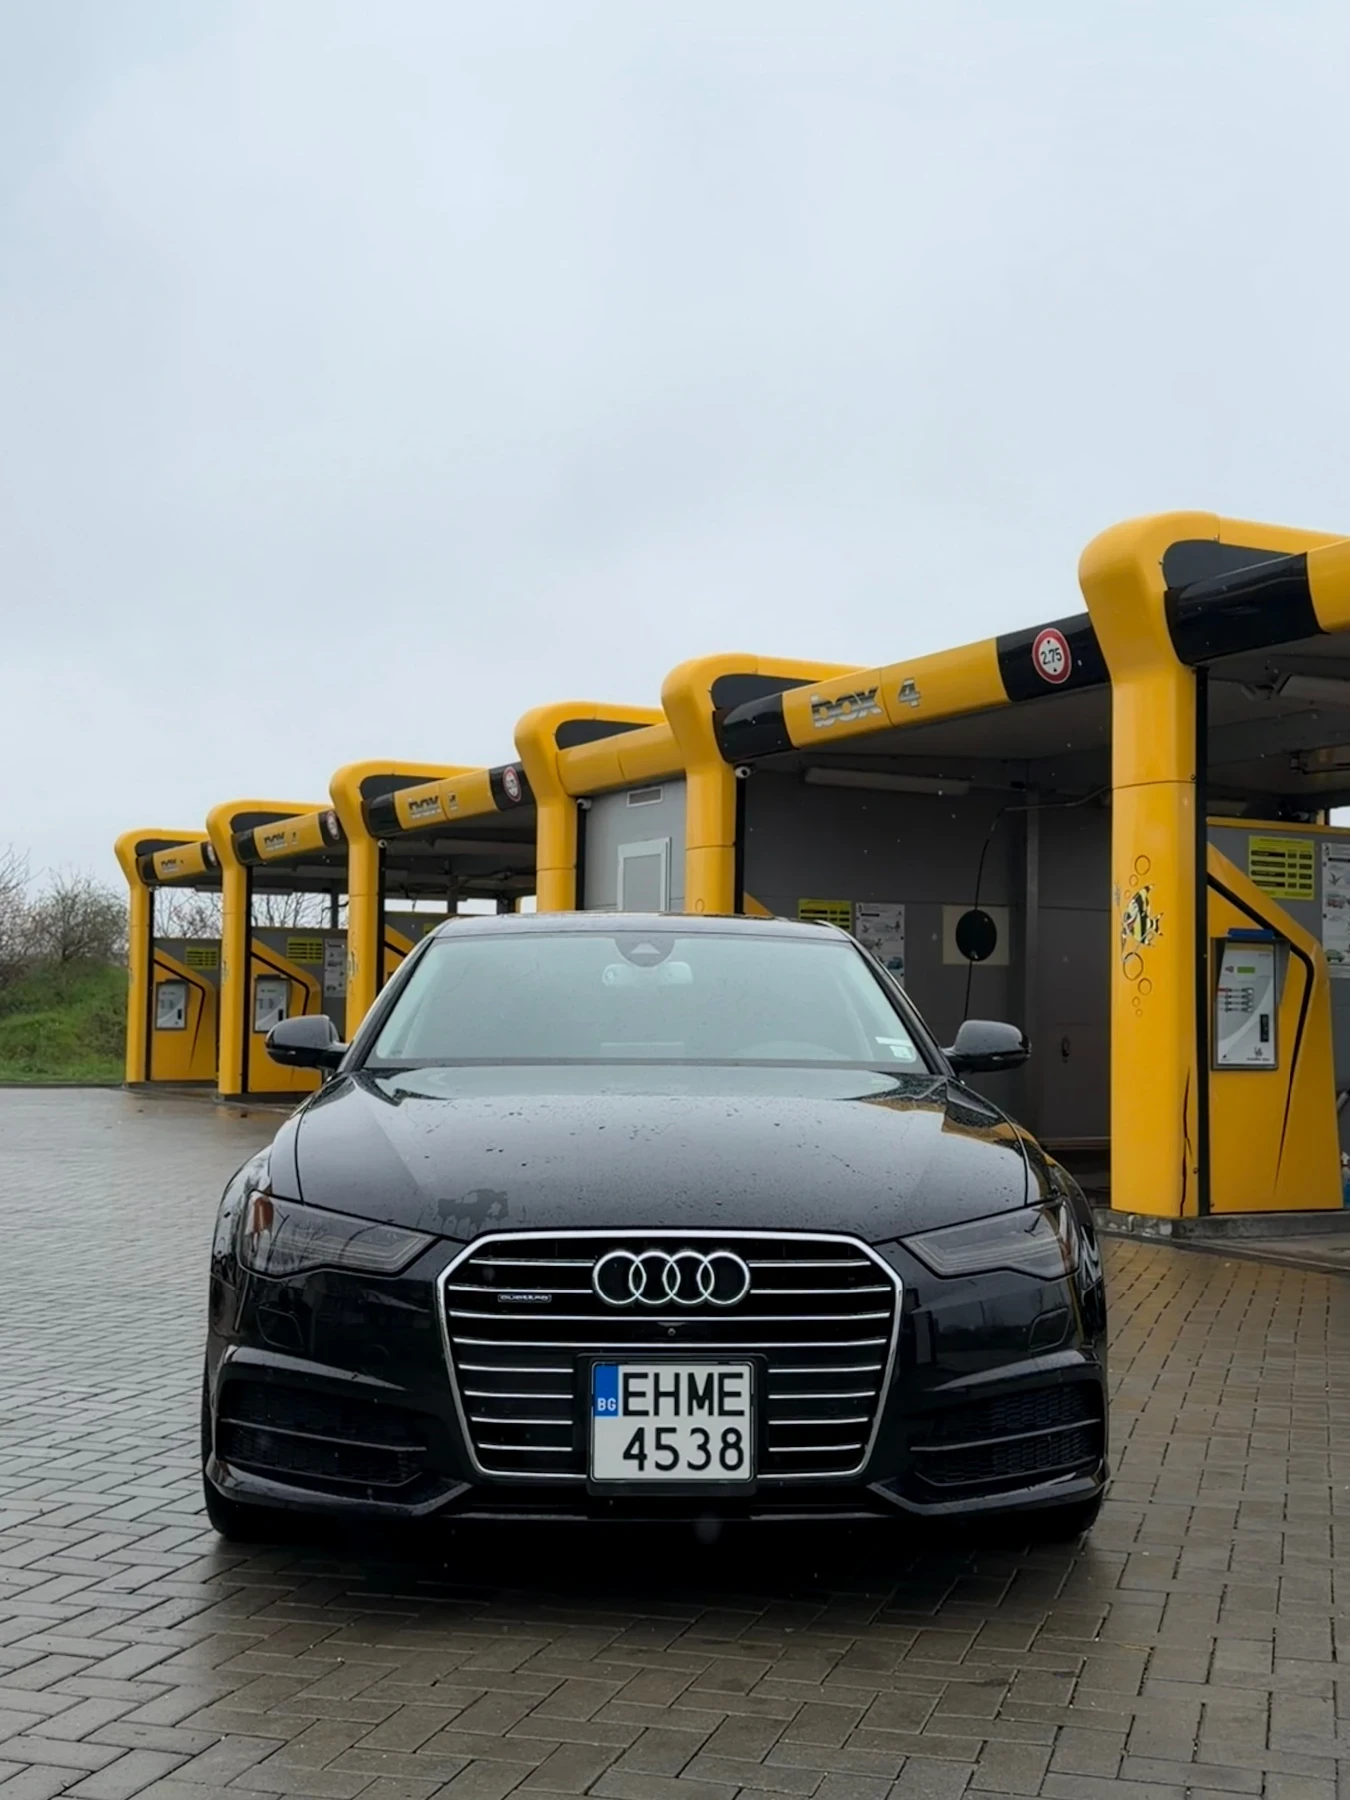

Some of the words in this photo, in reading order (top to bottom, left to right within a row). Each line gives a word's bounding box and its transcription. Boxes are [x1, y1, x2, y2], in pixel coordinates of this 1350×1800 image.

[811, 686, 883, 729] box
[898, 677, 921, 708] 4
[597, 1397, 617, 1411] BG
[622, 1372, 745, 1416] EHME
[622, 1427, 744, 1471] 4538
